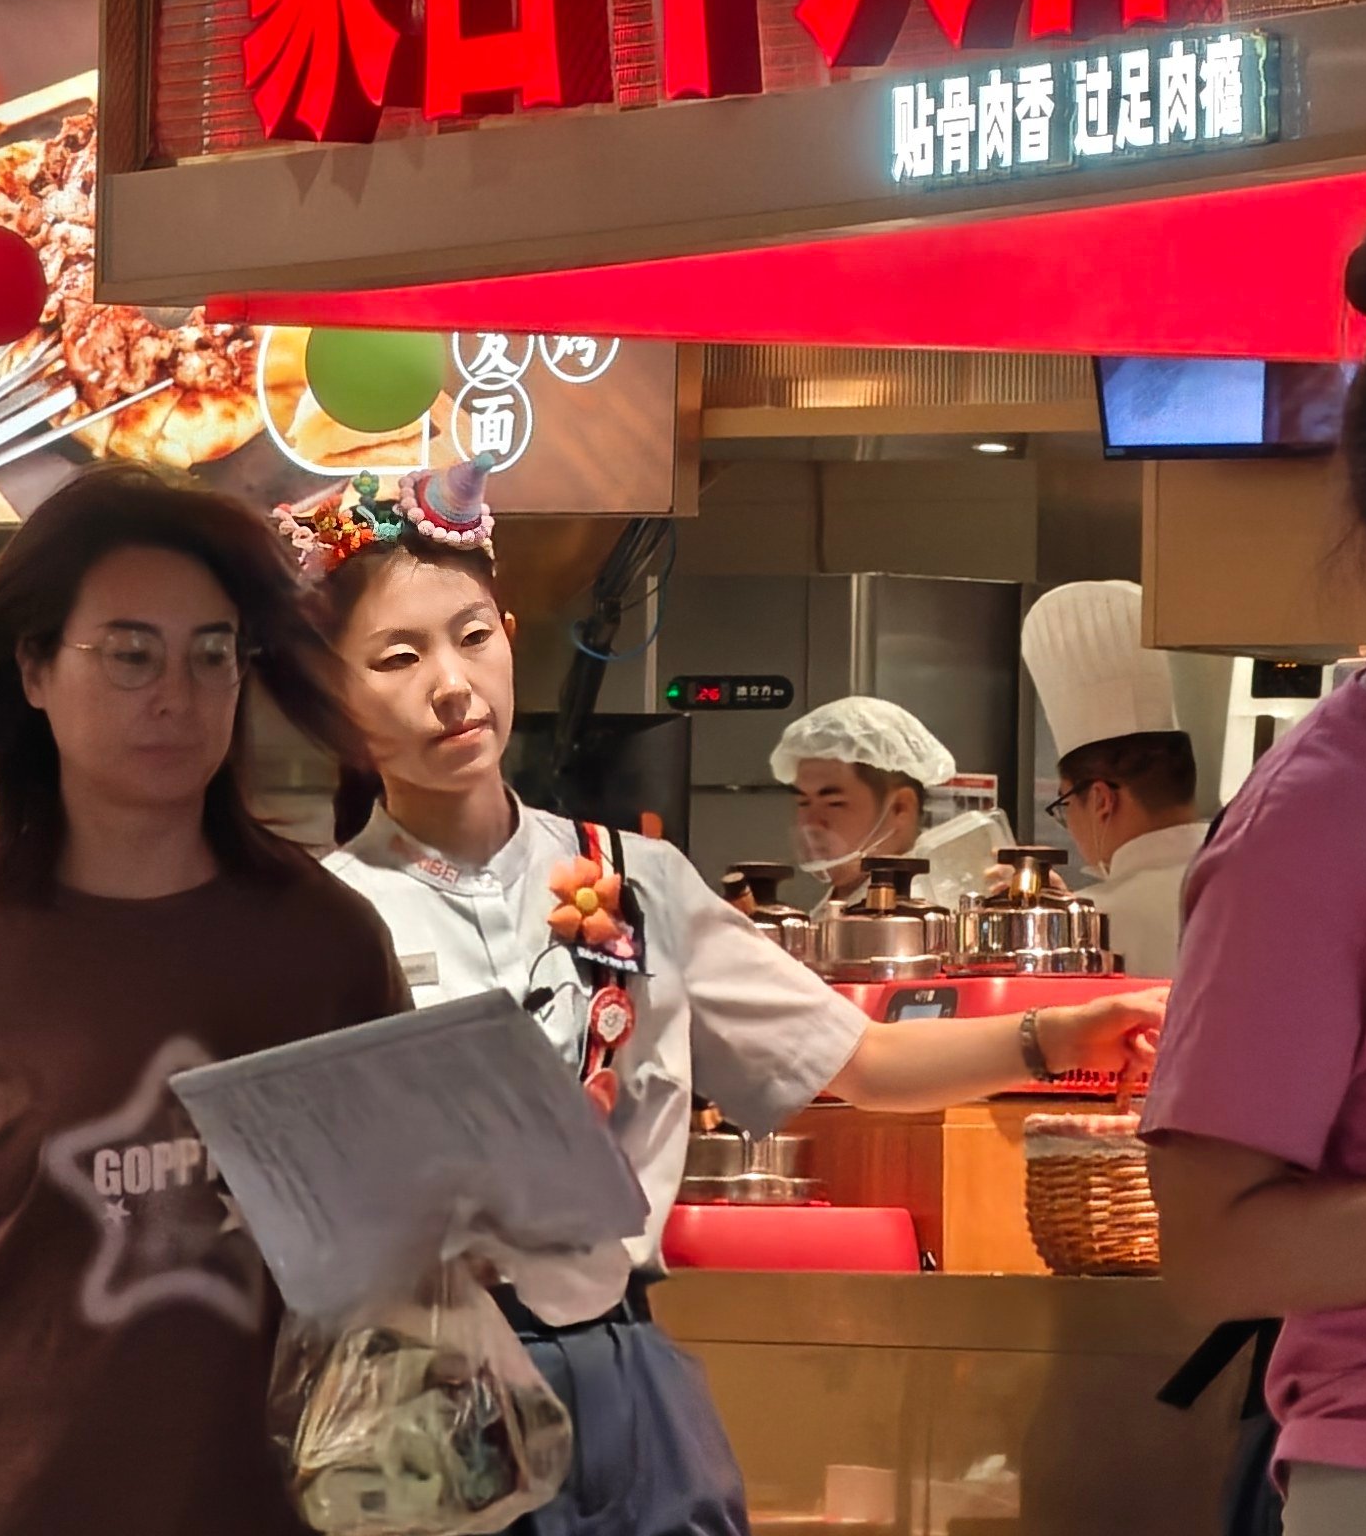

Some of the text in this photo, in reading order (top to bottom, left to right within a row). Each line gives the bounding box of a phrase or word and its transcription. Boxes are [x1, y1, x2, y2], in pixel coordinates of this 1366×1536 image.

[891, 33, 1244, 182] 贴骨肉香 过足肉瘾
